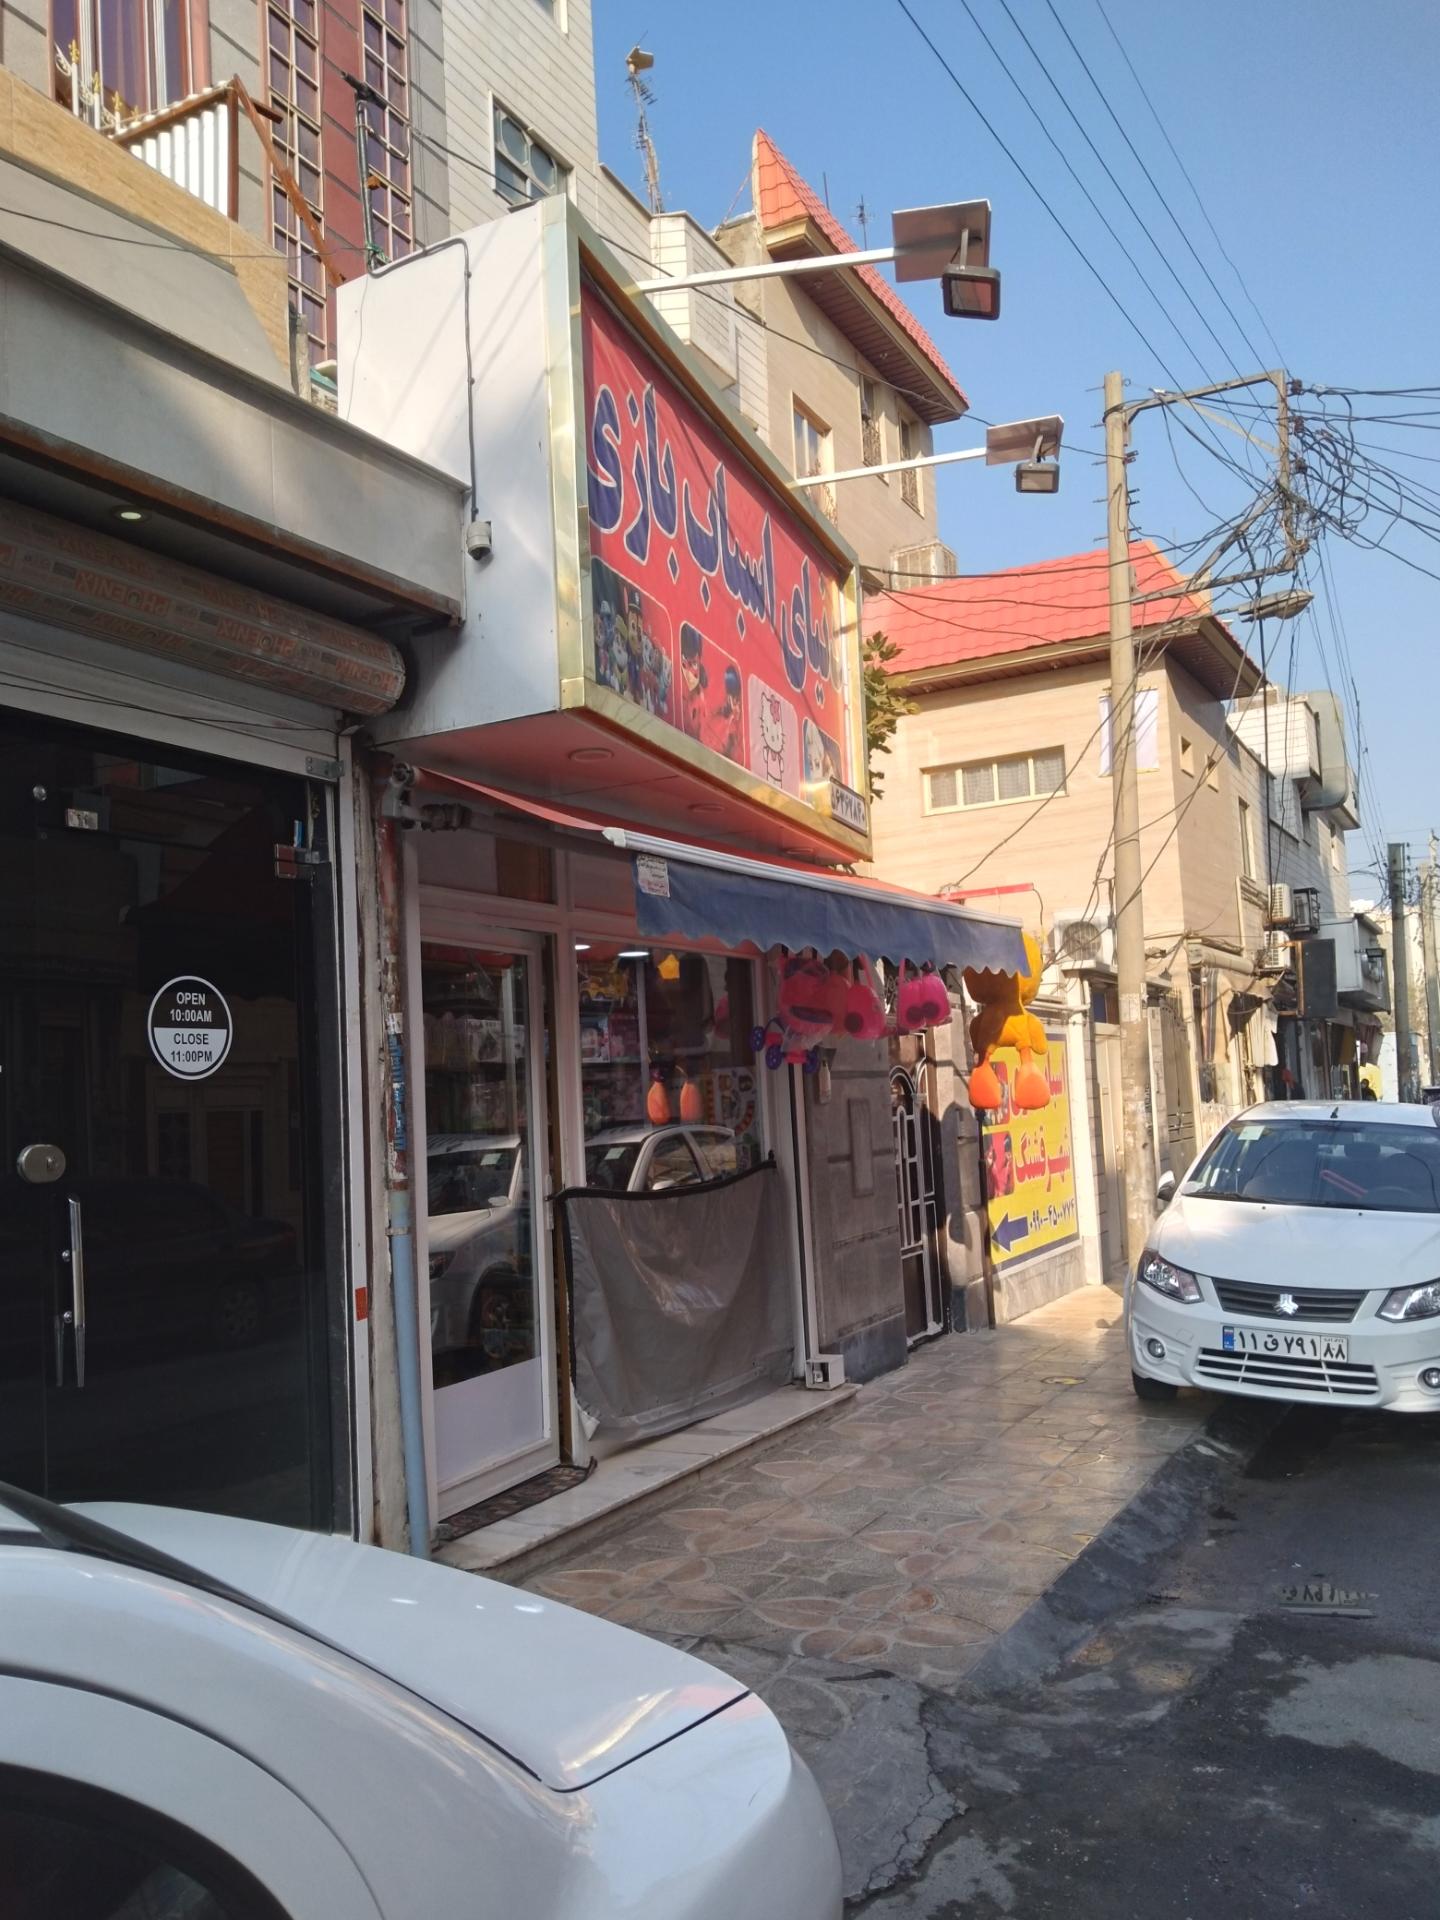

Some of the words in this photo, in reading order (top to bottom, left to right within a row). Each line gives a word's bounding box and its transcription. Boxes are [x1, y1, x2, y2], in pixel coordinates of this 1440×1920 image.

[587, 381, 679, 585] بازی
[682, 460, 776, 641] اسباب
[781, 555, 843, 708] دنیای
[176, 992, 206, 1006] OPEN
[169, 1009, 212, 1022] 10:00AM
[173, 1033, 209, 1045] CLOSE
[170, 1051, 213, 1062] 11:00PM
[1015, 1125, 1047, 1183] قشنگ
[1264, 1334, 1279, 1351] ق
[1284, 1336, 1317, 1357] ۷۹۱
[1323, 1342, 1346, 1360] ۸۸
